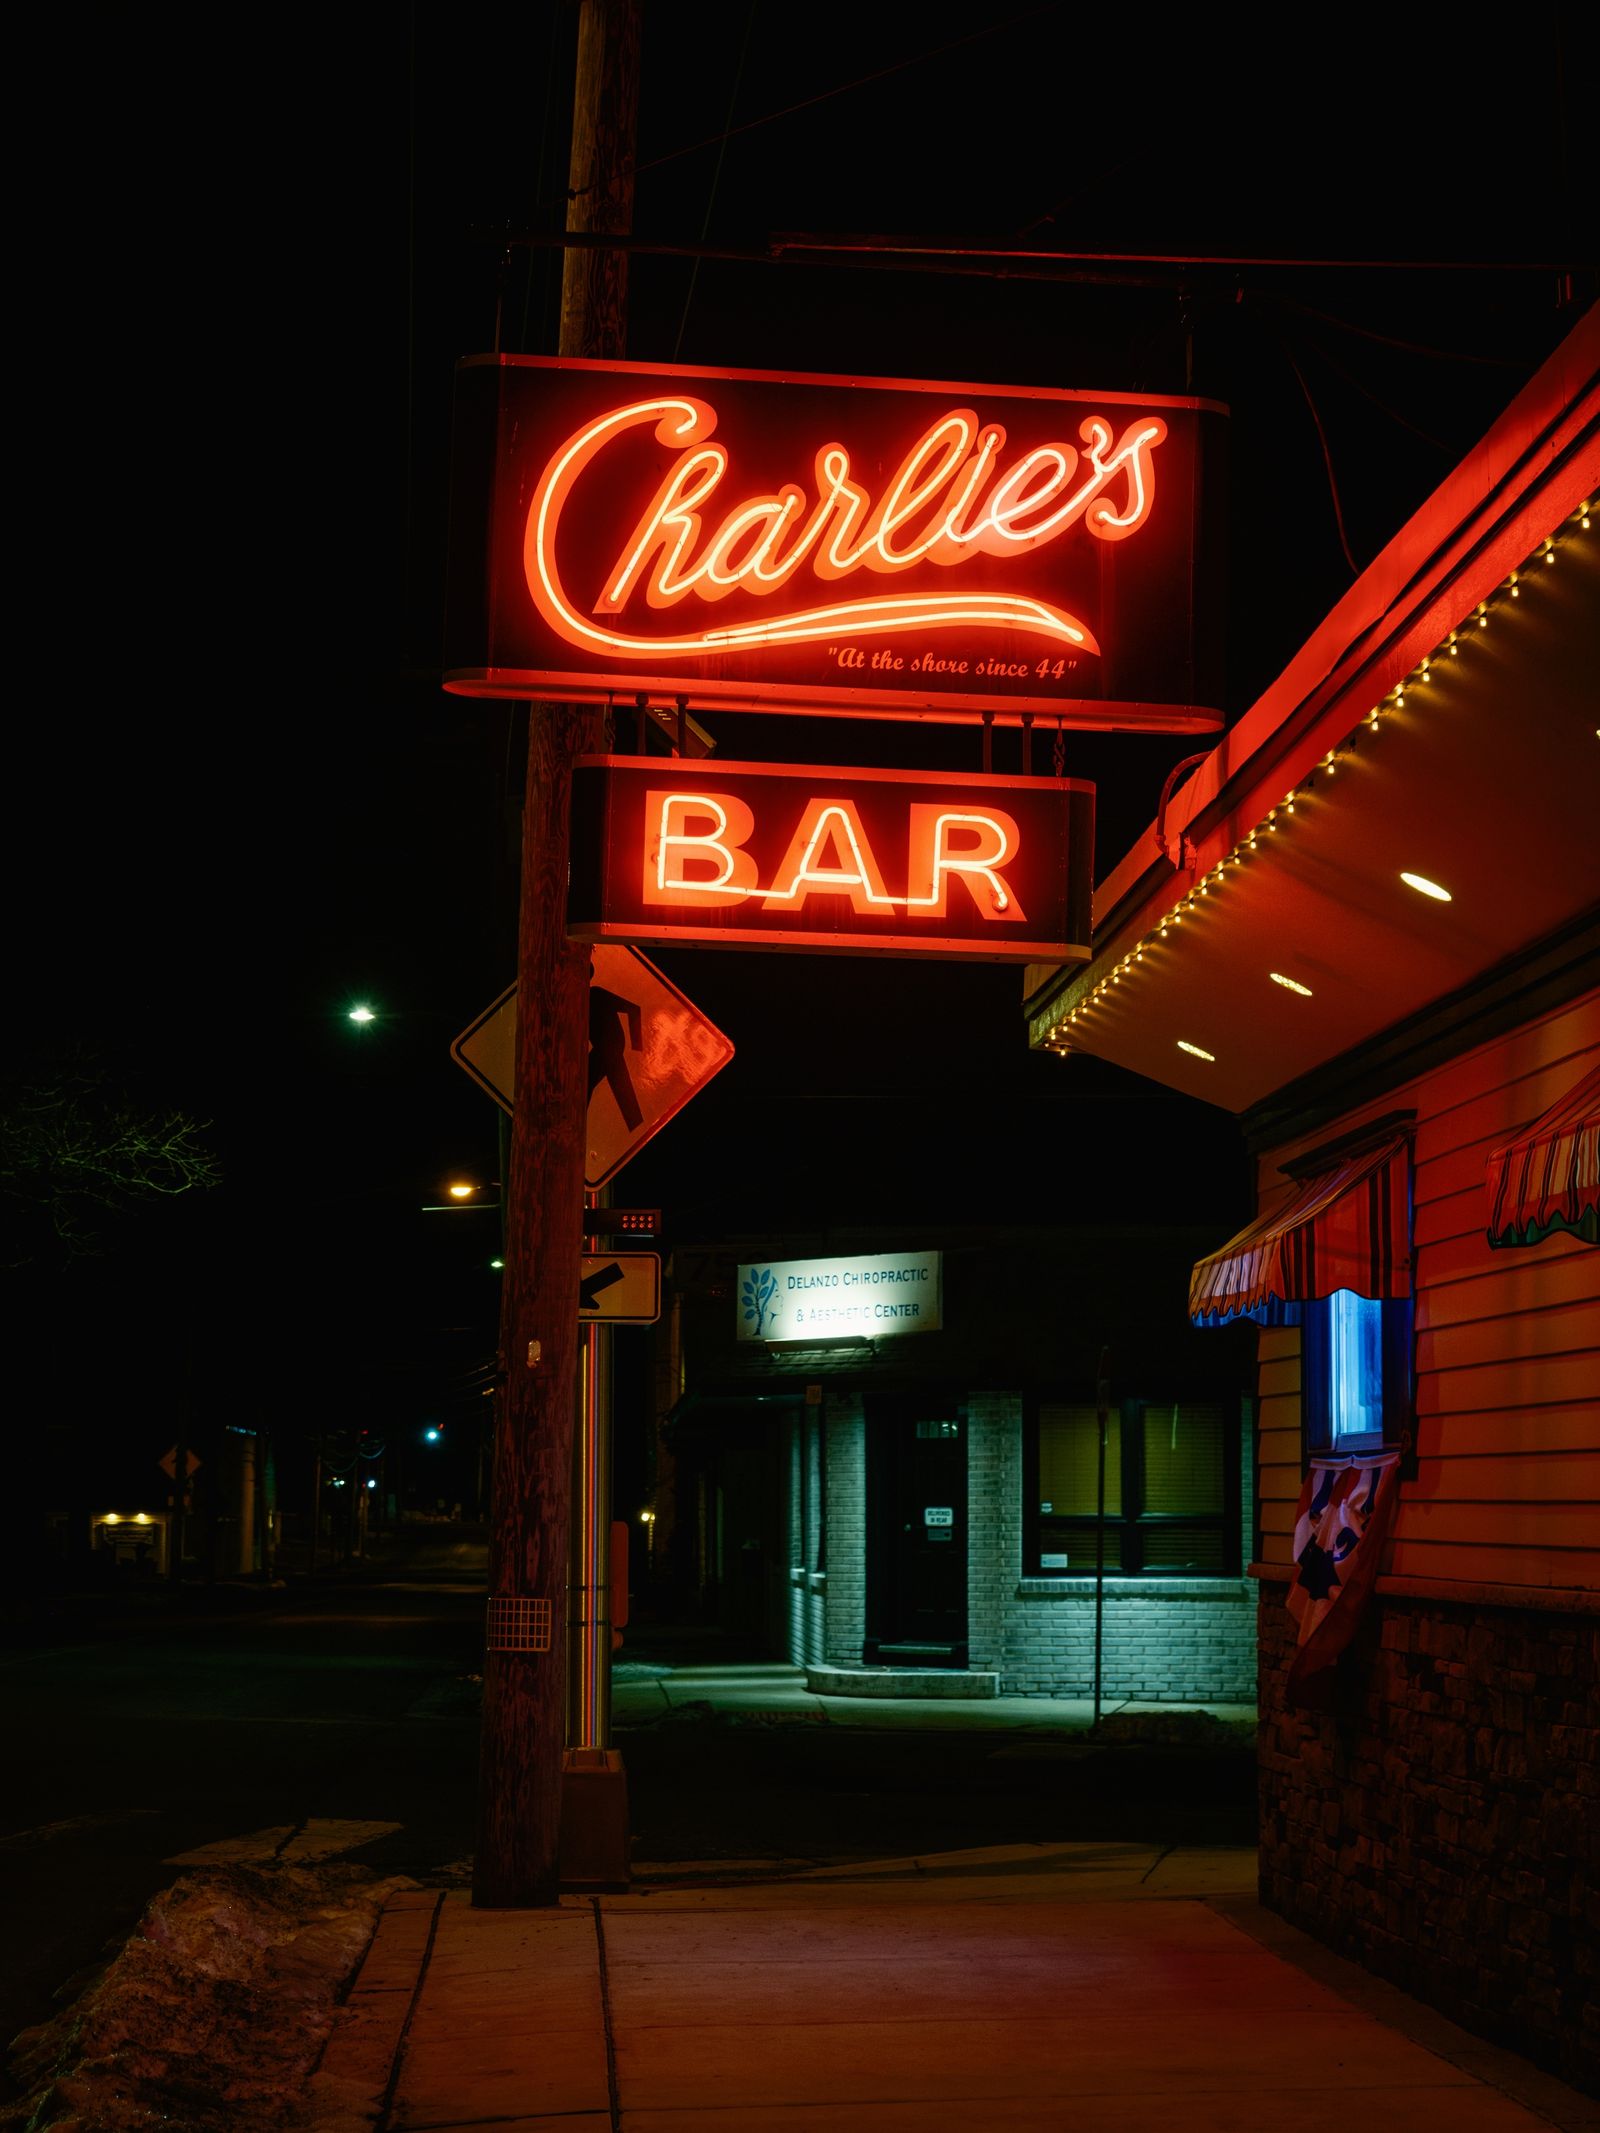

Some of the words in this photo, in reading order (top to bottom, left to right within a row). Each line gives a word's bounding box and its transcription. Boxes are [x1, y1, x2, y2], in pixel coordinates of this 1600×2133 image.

[524, 395, 1168, 656] Charlie's
[828, 647, 865, 668] "At
[871, 649, 904, 670] the
[910, 652, 969, 673] shore
[975, 657, 1029, 677] since
[1035, 658, 1077, 679] 44"
[642, 789, 1028, 921] BAR
[787, 1275, 839, 1290] DELANZO
[843, 1268, 929, 1286] CHIROPRACTIC
[796, 1308, 804, 1322] &
[810, 1306, 871, 1321] AESTHETIC
[874, 1303, 920, 1318] CENTER
